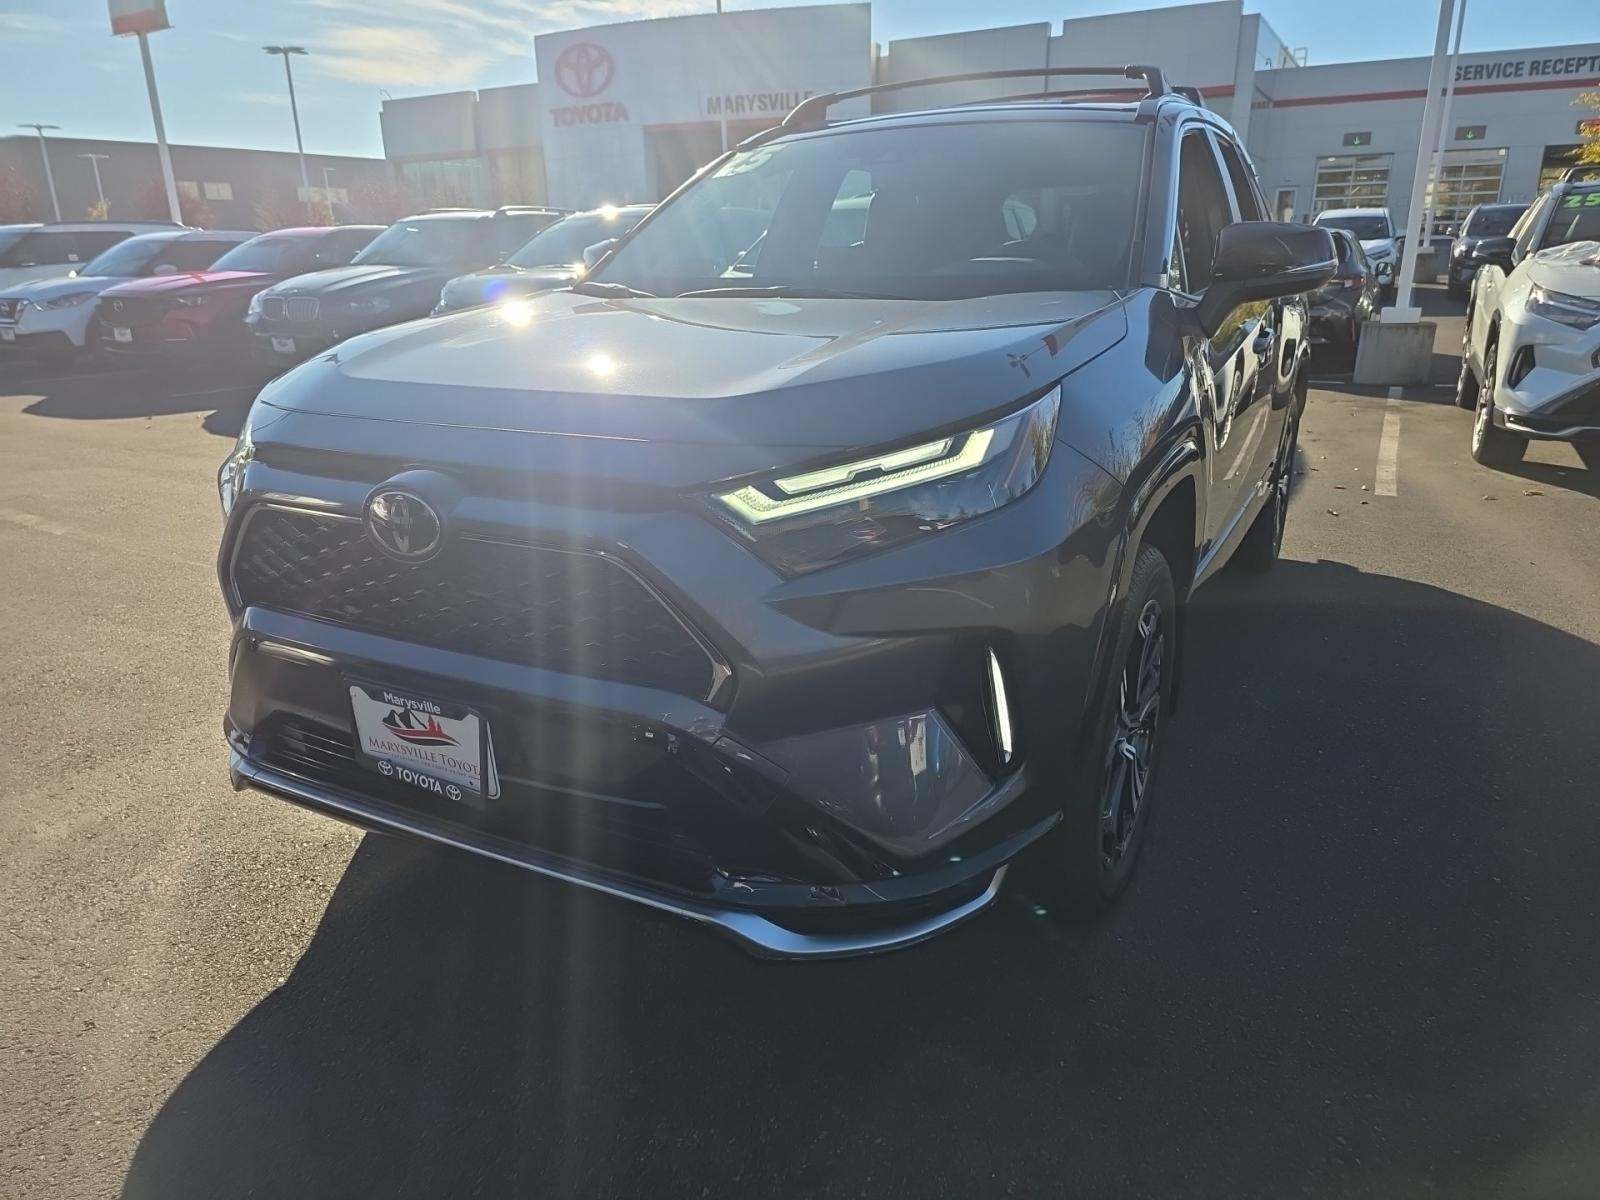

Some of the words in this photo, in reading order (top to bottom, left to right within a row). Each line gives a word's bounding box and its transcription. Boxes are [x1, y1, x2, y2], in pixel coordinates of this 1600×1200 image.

[1455, 61, 1525, 81] SERVICE
[550, 102, 628, 127] TOYOTA
[383, 691, 441, 714] Marysville
[369, 737, 438, 762] MARYSVILLE
[396, 767, 443, 794] TOYOTA
